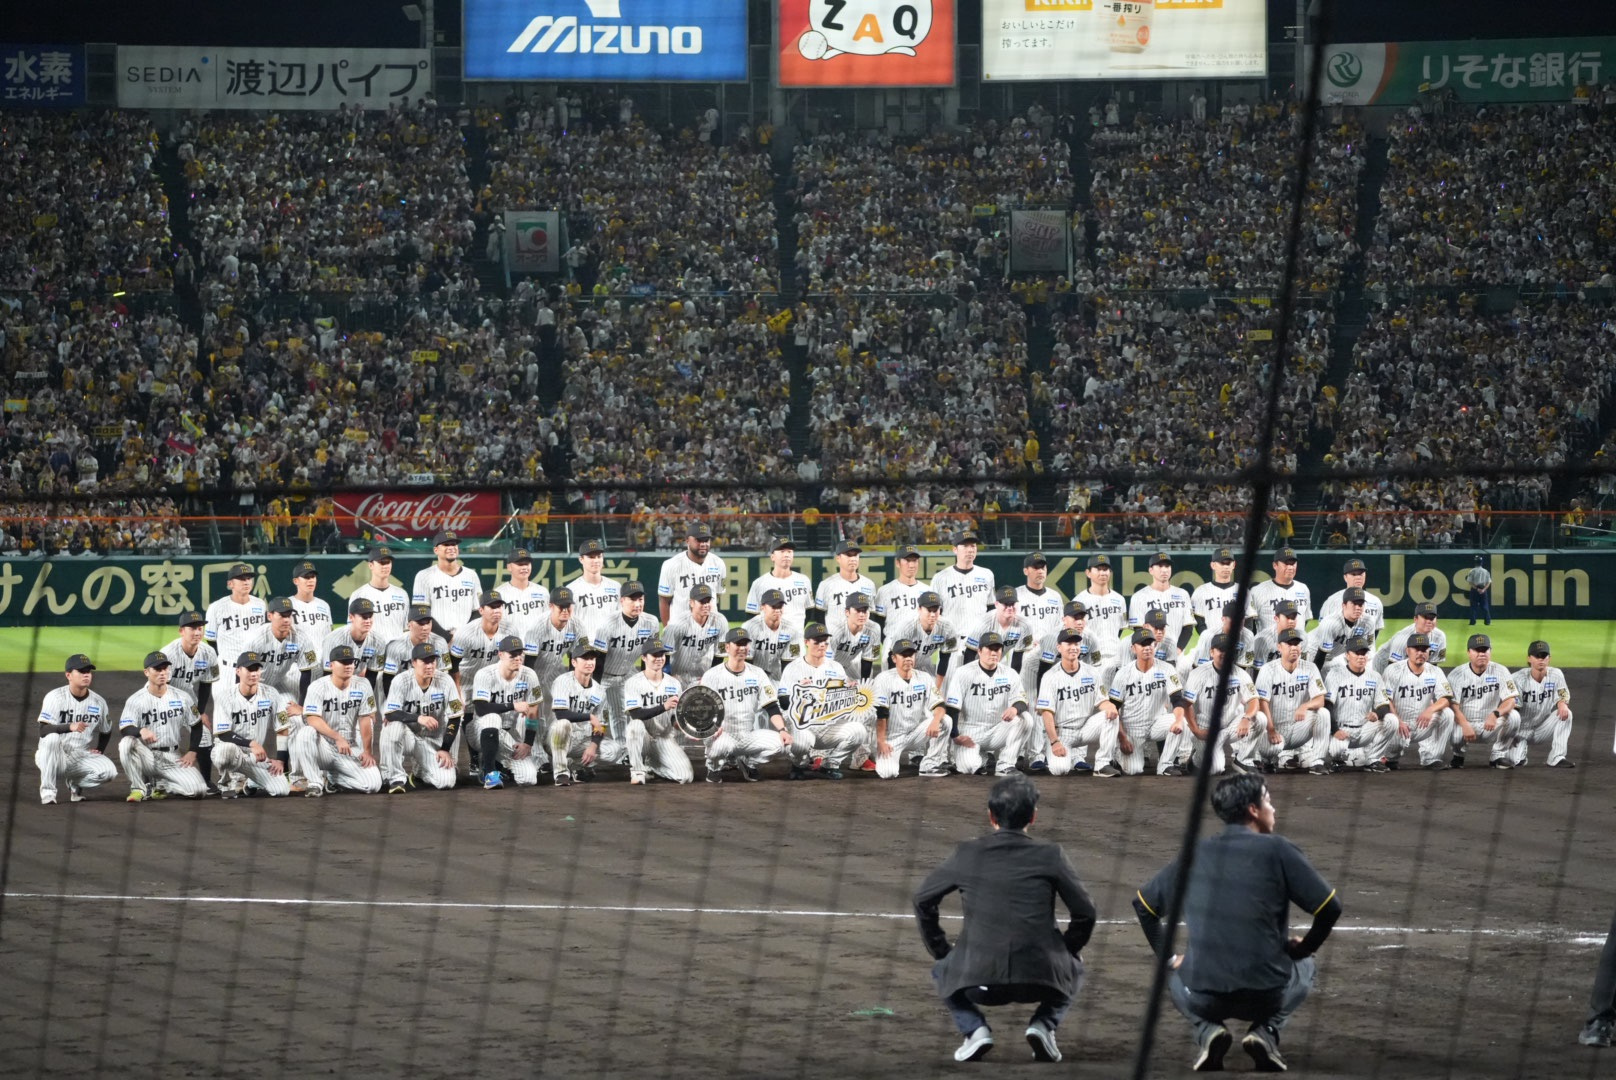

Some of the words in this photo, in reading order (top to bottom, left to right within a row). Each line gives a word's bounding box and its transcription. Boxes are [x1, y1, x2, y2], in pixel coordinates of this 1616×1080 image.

[1104, 2, 1142, 14] 一番搾り
[822, 0, 919, 43] ZAQ
[1002, 20, 1075, 30] おいしいとこだけ
[1002, 38, 1053, 48] 搾ってます。
[5, 51, 72, 84] 水素
[127, 66, 202, 82] SEDIA
[1421, 51, 1603, 90] りそな銀行
[226, 59, 428, 97] 渡辺パイプ
[5, 87, 73, 100] エネルギー
[354, 493, 479, 532] Coca-Cola
[679, 572, 721, 588] Tigers
[1366, 554, 1590, 607] Joshin
[433, 584, 474, 602] Tigers
[947, 582, 989, 600] Tigers
[372, 600, 405, 616] igers
[504, 599, 545, 615] Tigers
[578, 591, 619, 609] Tigers
[1147, 599, 1186, 614] Tigers
[1020, 603, 1059, 619] Tigers
[1086, 604, 1121, 620] Tigers
[682, 634, 717, 650] Tigers
[718, 685, 760, 702] Tigers
[970, 683, 1011, 701] Tigers
[1057, 683, 1095, 702] Tigers
[1125, 679, 1166, 697] Tigers
[1462, 683, 1500, 700] Tigers
[60, 709, 100, 724] Tigers
[142, 706, 184, 726] Tigers
[232, 706, 273, 726] Tigers
[799, 695, 860, 725] CHAMPIONS
